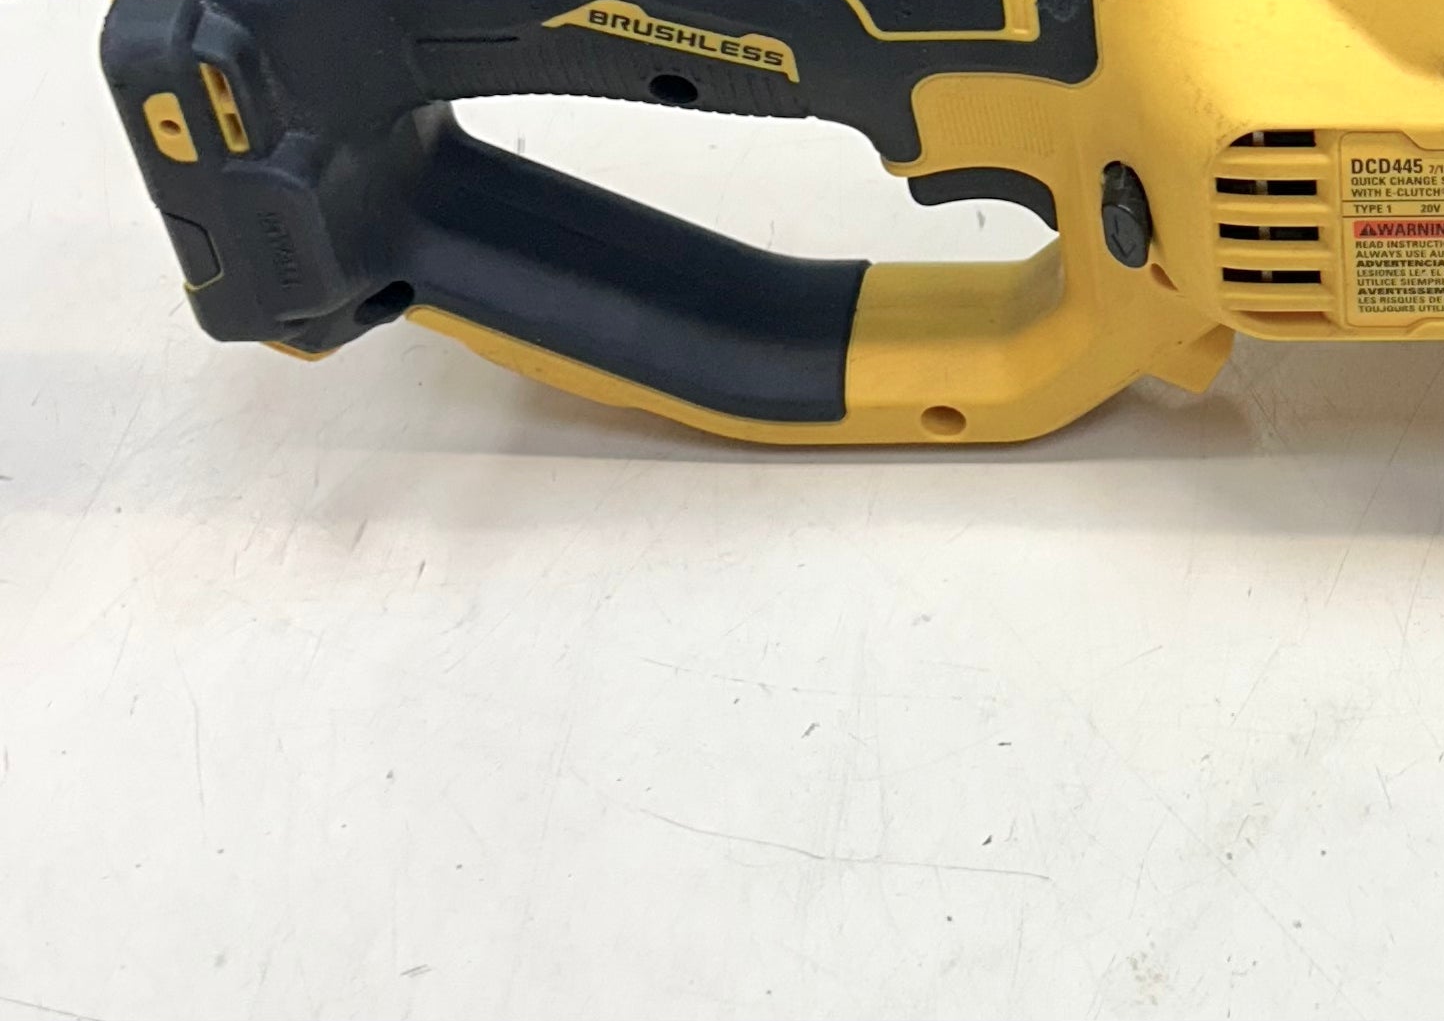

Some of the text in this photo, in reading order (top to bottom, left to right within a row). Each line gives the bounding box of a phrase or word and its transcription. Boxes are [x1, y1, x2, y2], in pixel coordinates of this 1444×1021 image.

[588, 9, 783, 67] BRUSHLESS
[1351, 158, 1423, 174] DCD445
[1351, 177, 1386, 186] QUICK
[1390, 176, 1438, 185] CHANGE
[1351, 188, 1380, 197] WITH
[1354, 204, 1392, 213] TYPE 1
[1421, 204, 1441, 213] 20V
[1355, 241, 1384, 249] READ
[1356, 250, 1404, 258] ALWAYS
[1405, 250, 1427, 258] USE
[1357, 269, 1406, 277] LESIONES
[1358, 296, 1377, 304] LES
[1379, 296, 1426, 304] RISQUES
[1358, 305, 1415, 313] TOUJOURS
